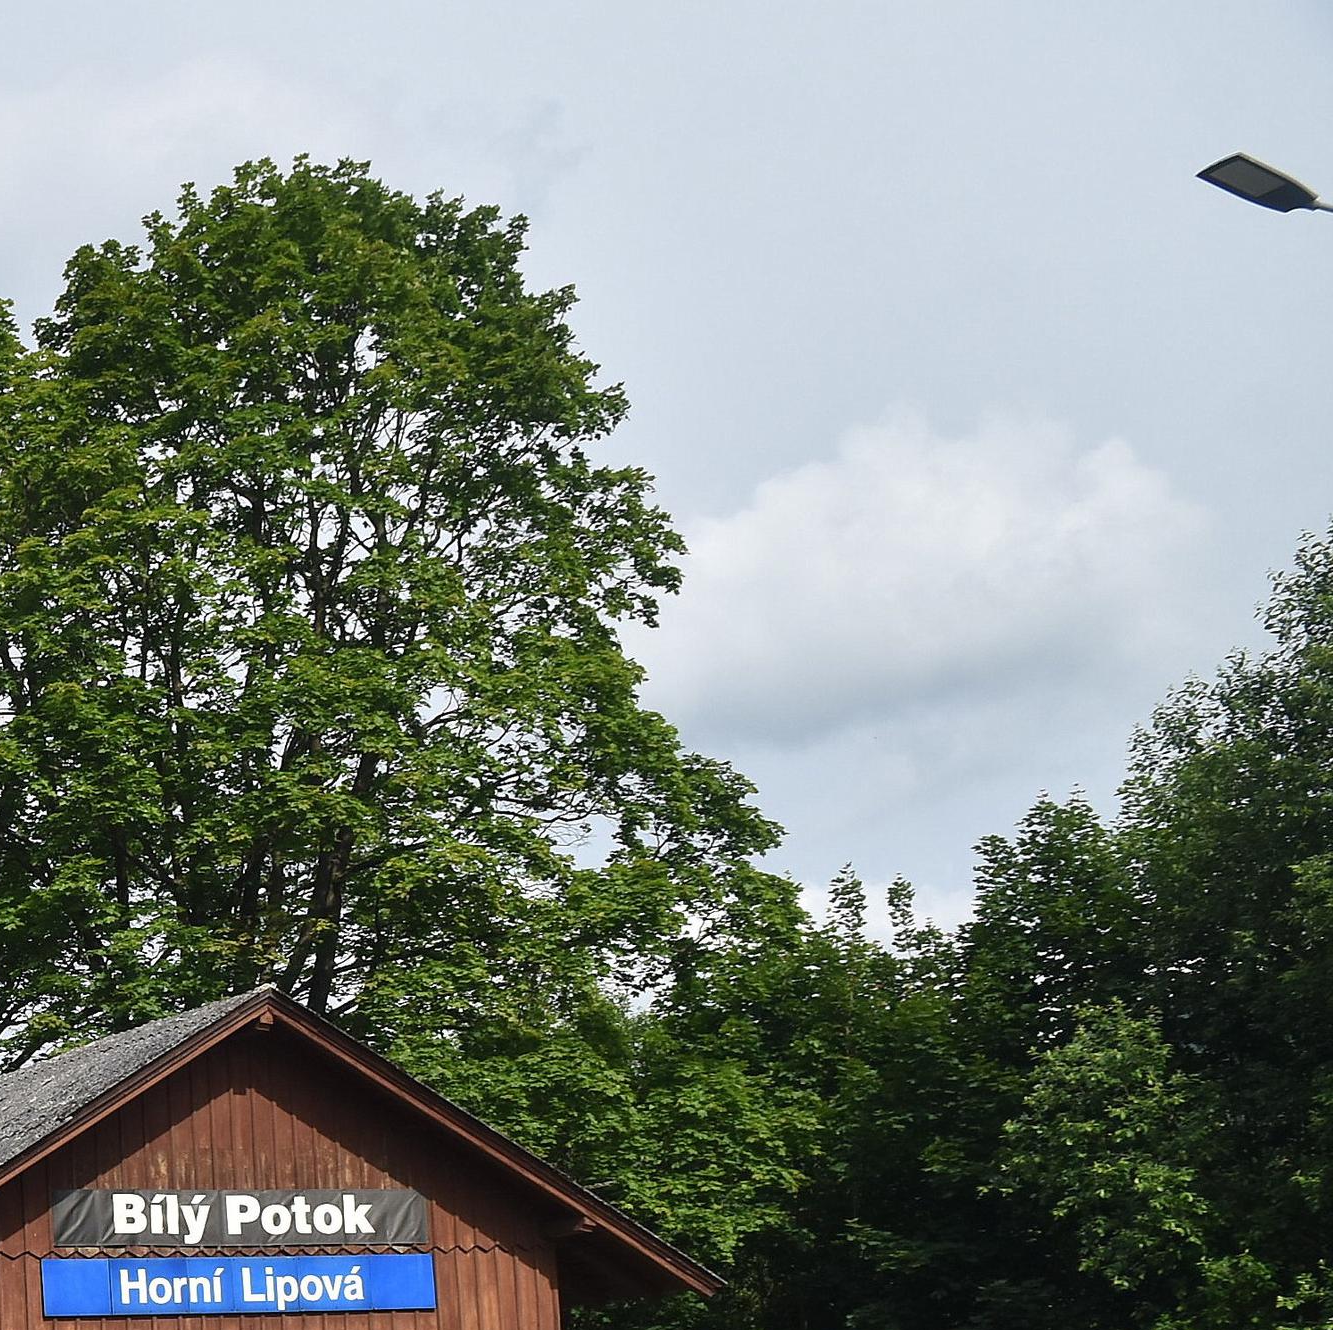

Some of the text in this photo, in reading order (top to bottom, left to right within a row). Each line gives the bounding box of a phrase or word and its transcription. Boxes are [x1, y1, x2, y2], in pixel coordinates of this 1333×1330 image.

[112, 1193, 376, 1244] Bílý Potok
[119, 1265, 365, 1311] Horní Lipová
